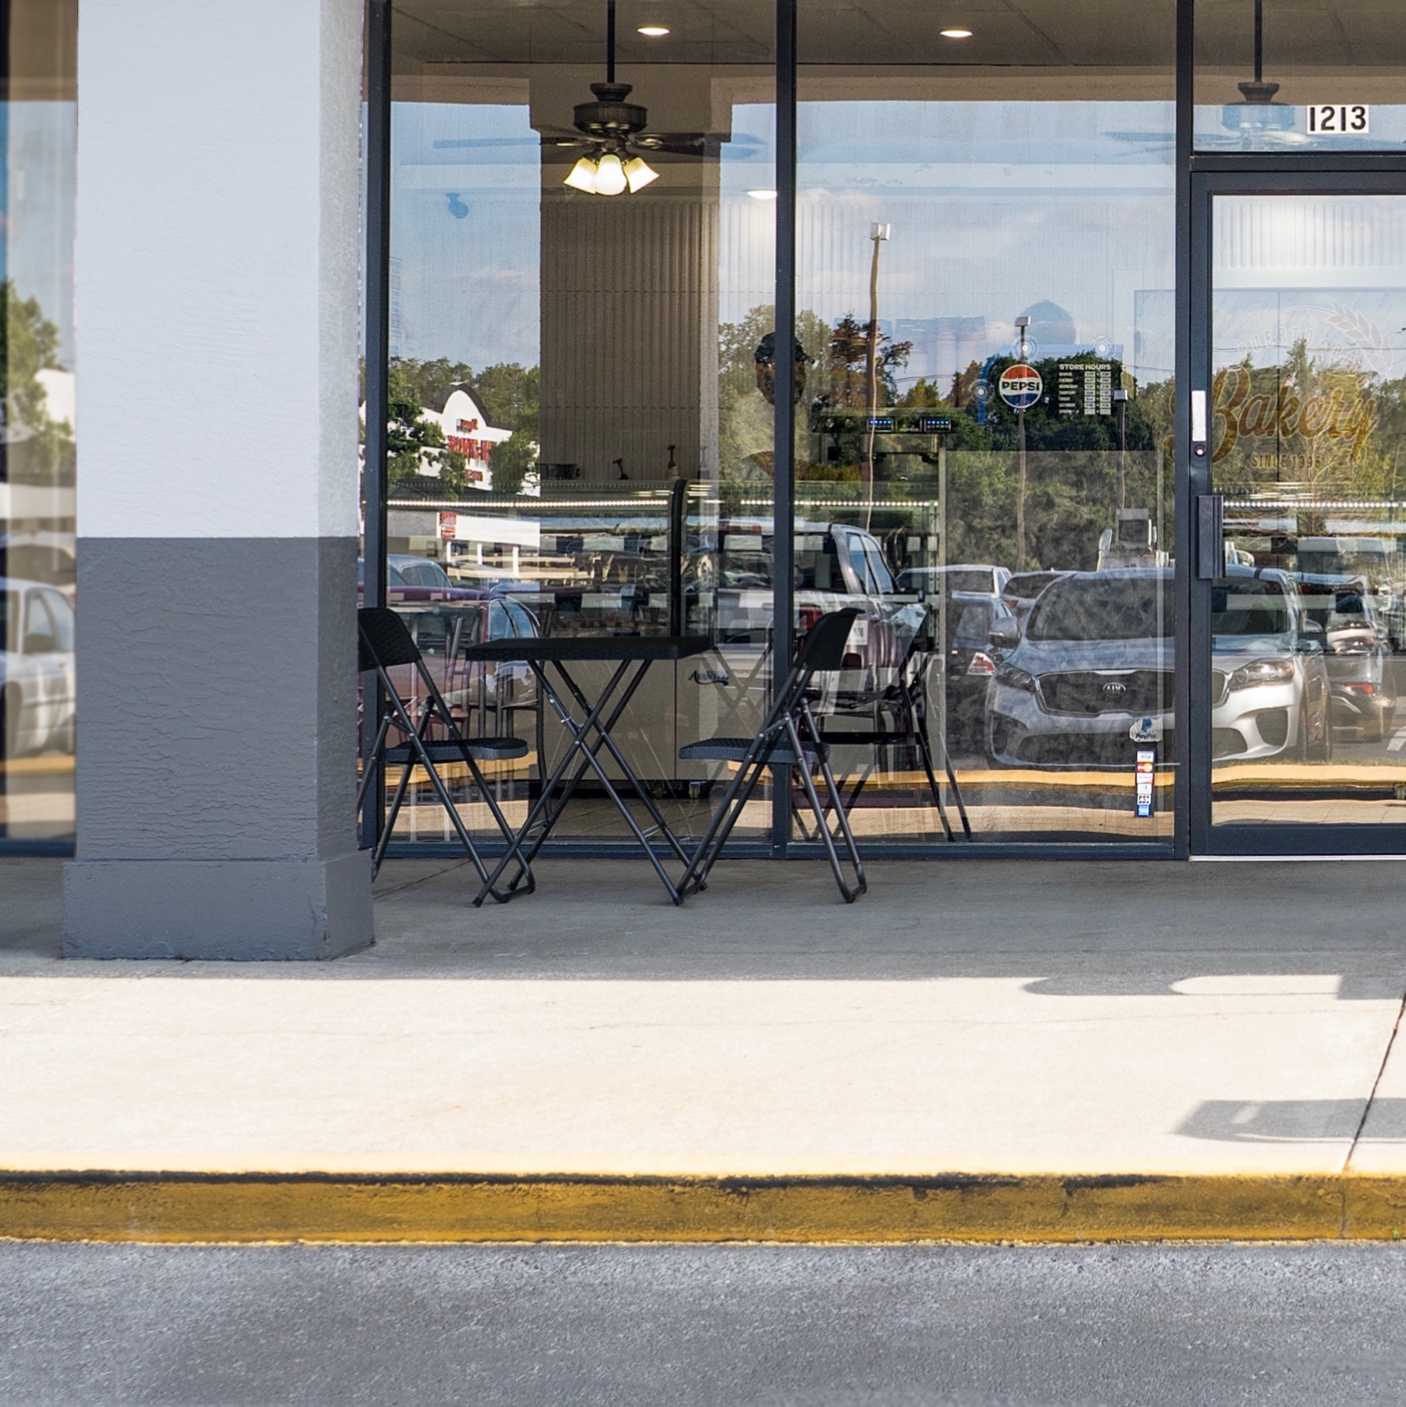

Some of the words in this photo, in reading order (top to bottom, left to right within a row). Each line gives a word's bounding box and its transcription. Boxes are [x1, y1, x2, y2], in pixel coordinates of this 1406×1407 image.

[1309, 106, 1366, 131] 1213
[1237, 326, 1315, 357] PUERTO
[1085, 363, 1111, 371] HOURS
[1002, 381, 1040, 392] PEPSI
[1164, 364, 1380, 463] Bakery
[1252, 453, 1287, 468] SINCE
[1291, 454, 1321, 469] 1996
